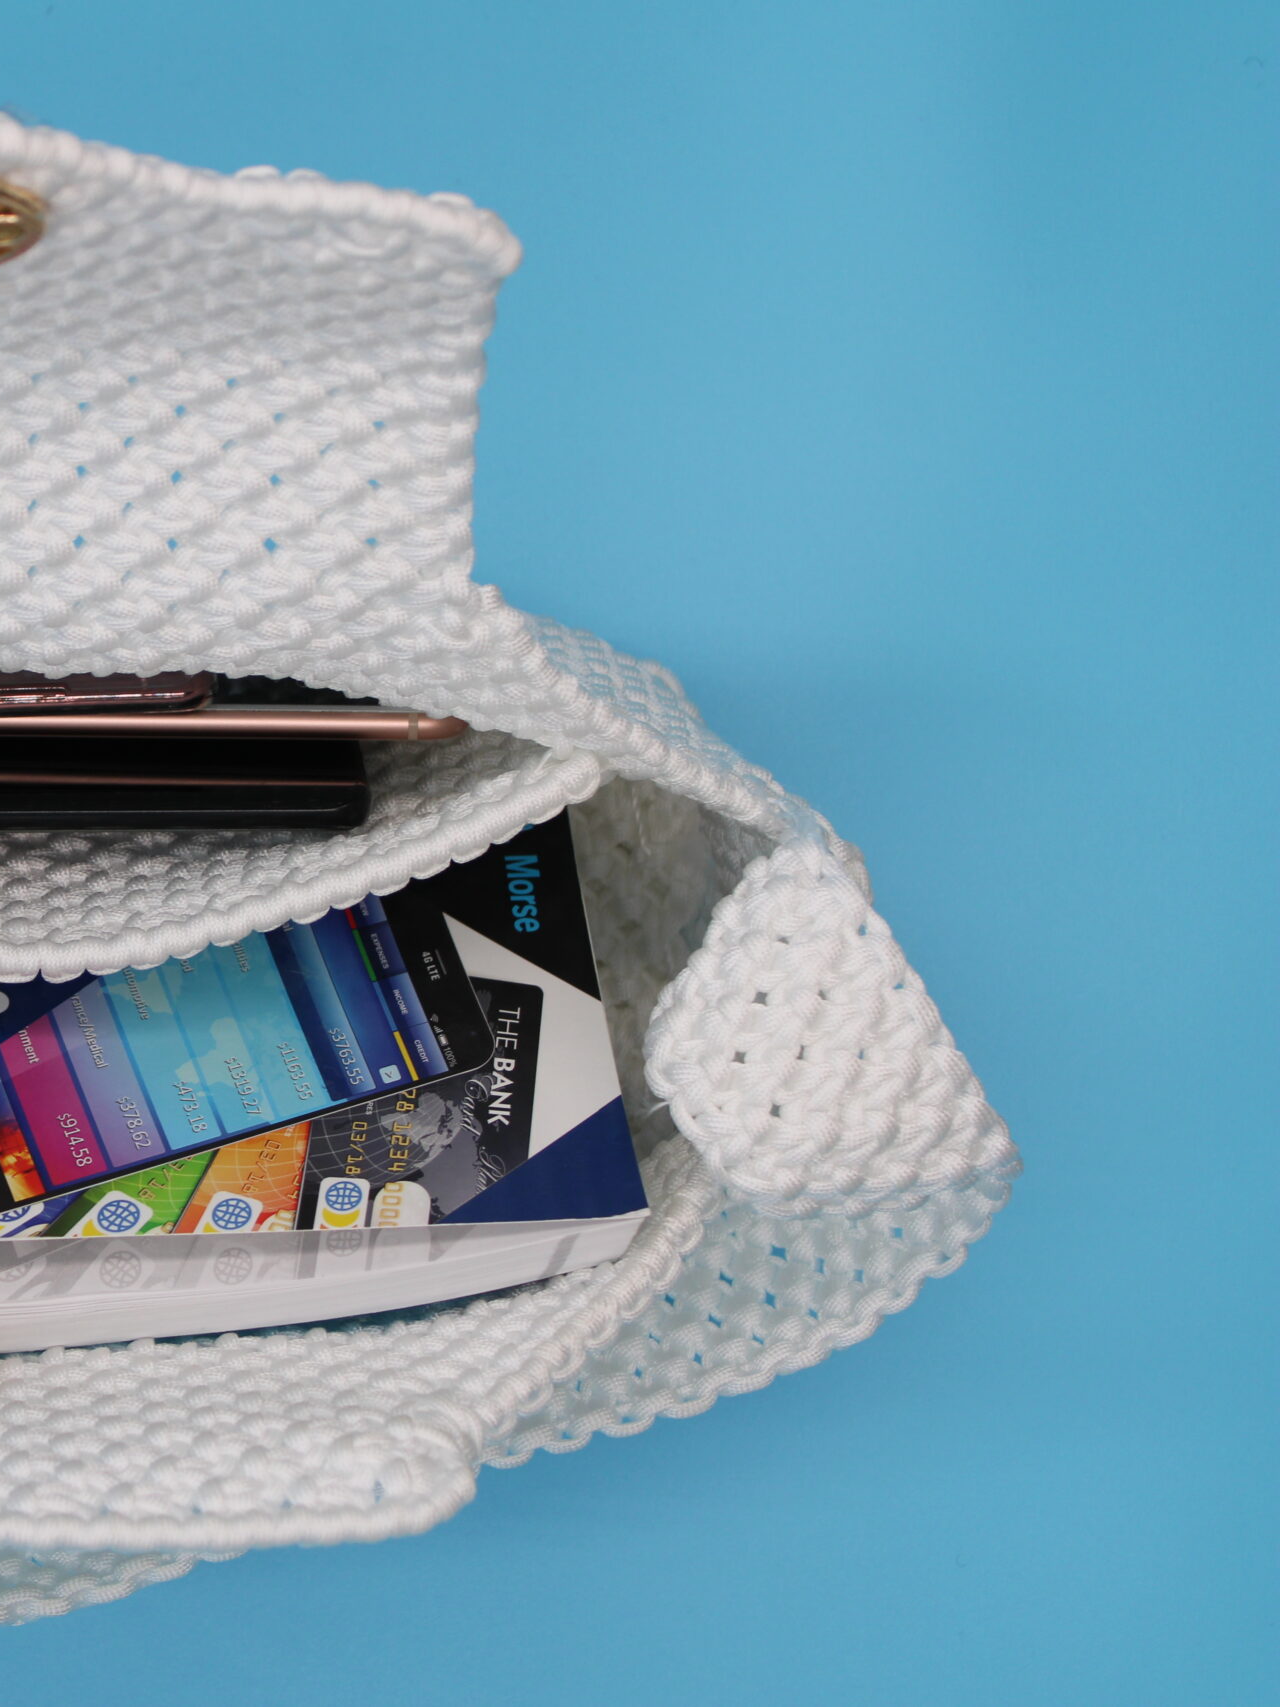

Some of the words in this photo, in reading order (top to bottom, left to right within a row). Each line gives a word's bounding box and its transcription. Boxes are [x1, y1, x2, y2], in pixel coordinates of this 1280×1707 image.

[504, 854, 541, 933] Morse
[370, 932, 390, 970] EXPENSES
[421, 951, 433, 965] 4G
[426, 966, 441, 982] LTE
[392, 988, 409, 1016] INCOME
[495, 1006, 521, 1050] THE
[17, 1025, 40, 1065] nment
[276, 1041, 314, 1101] $1163.55
[327, 1027, 365, 1086] $3763.55
[414, 1038, 430, 1064] CREDIT
[443, 1046, 460, 1069] 100%
[173, 1081, 209, 1134] $473.18
[224, 1055, 263, 1117] $1319.27
[458, 1072, 497, 1137] Card
[487, 1057, 516, 1127] BANK
[55, 1112, 94, 1169] $914.58
[115, 1096, 152, 1151] $378.62
[345, 1120, 368, 1176] 03/18
[387, 1119, 413, 1173] 1234
[138, 1155, 194, 1201] 3/18
[241, 1138, 282, 1196] 03/18
